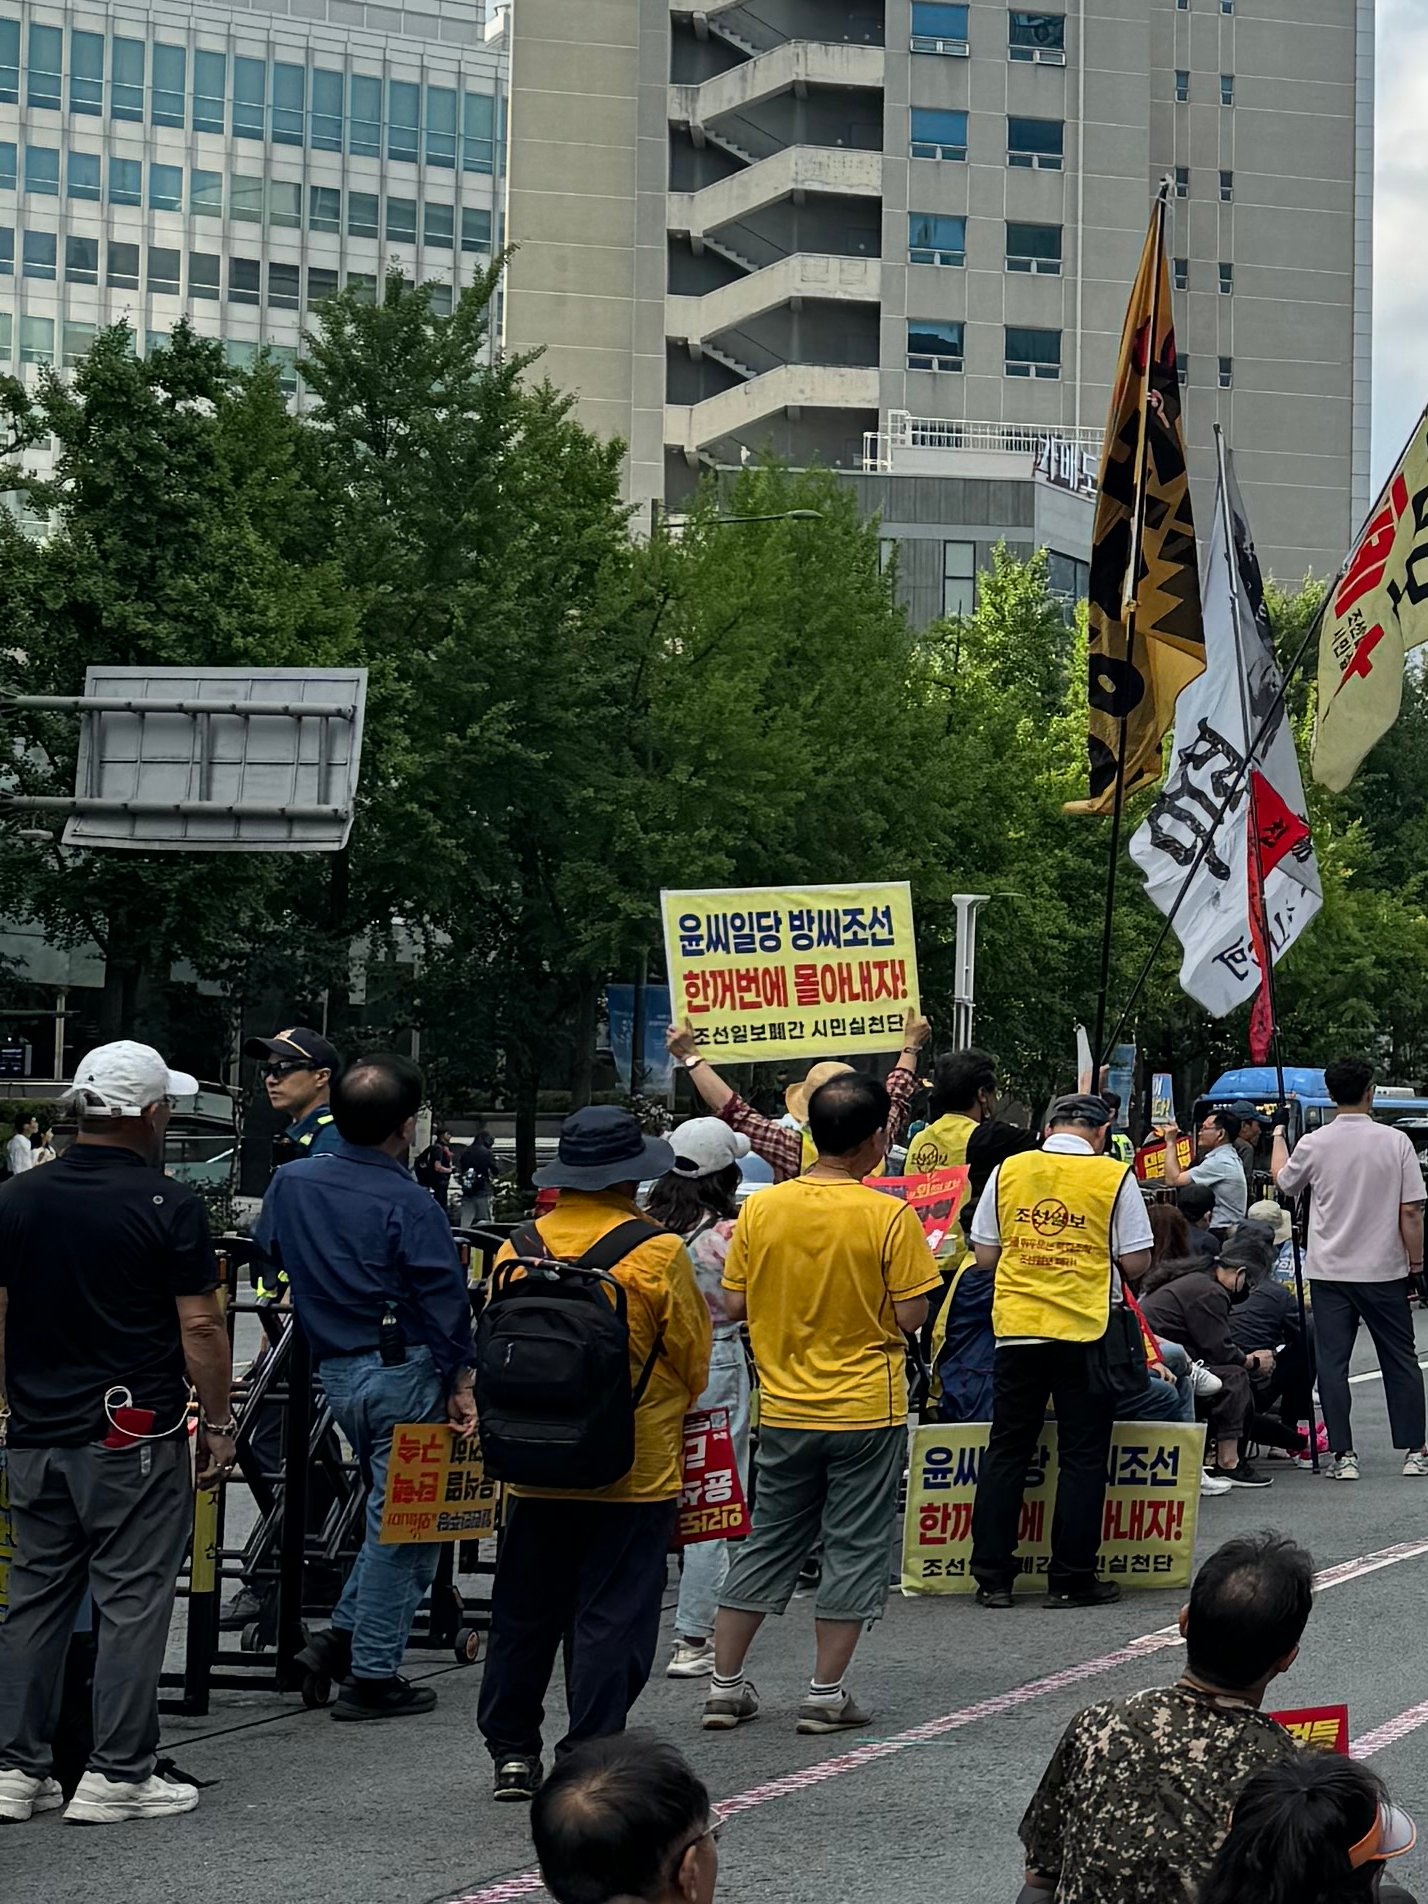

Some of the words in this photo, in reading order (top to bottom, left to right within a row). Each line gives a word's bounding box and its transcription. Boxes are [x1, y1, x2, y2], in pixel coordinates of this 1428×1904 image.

[679, 910, 782, 957] 윤씨일당
[788, 905, 895, 952] 방씨조선
[683, 965, 789, 1014] 한꺼번에
[794, 959, 908, 1007] 몰아내자!
[811, 1013, 905, 1039] 시민실천단
[398, 1433, 444, 1464] 구속
[392, 1471, 439, 1504] 탄핵
[680, 1503, 742, 1535] 인간도
